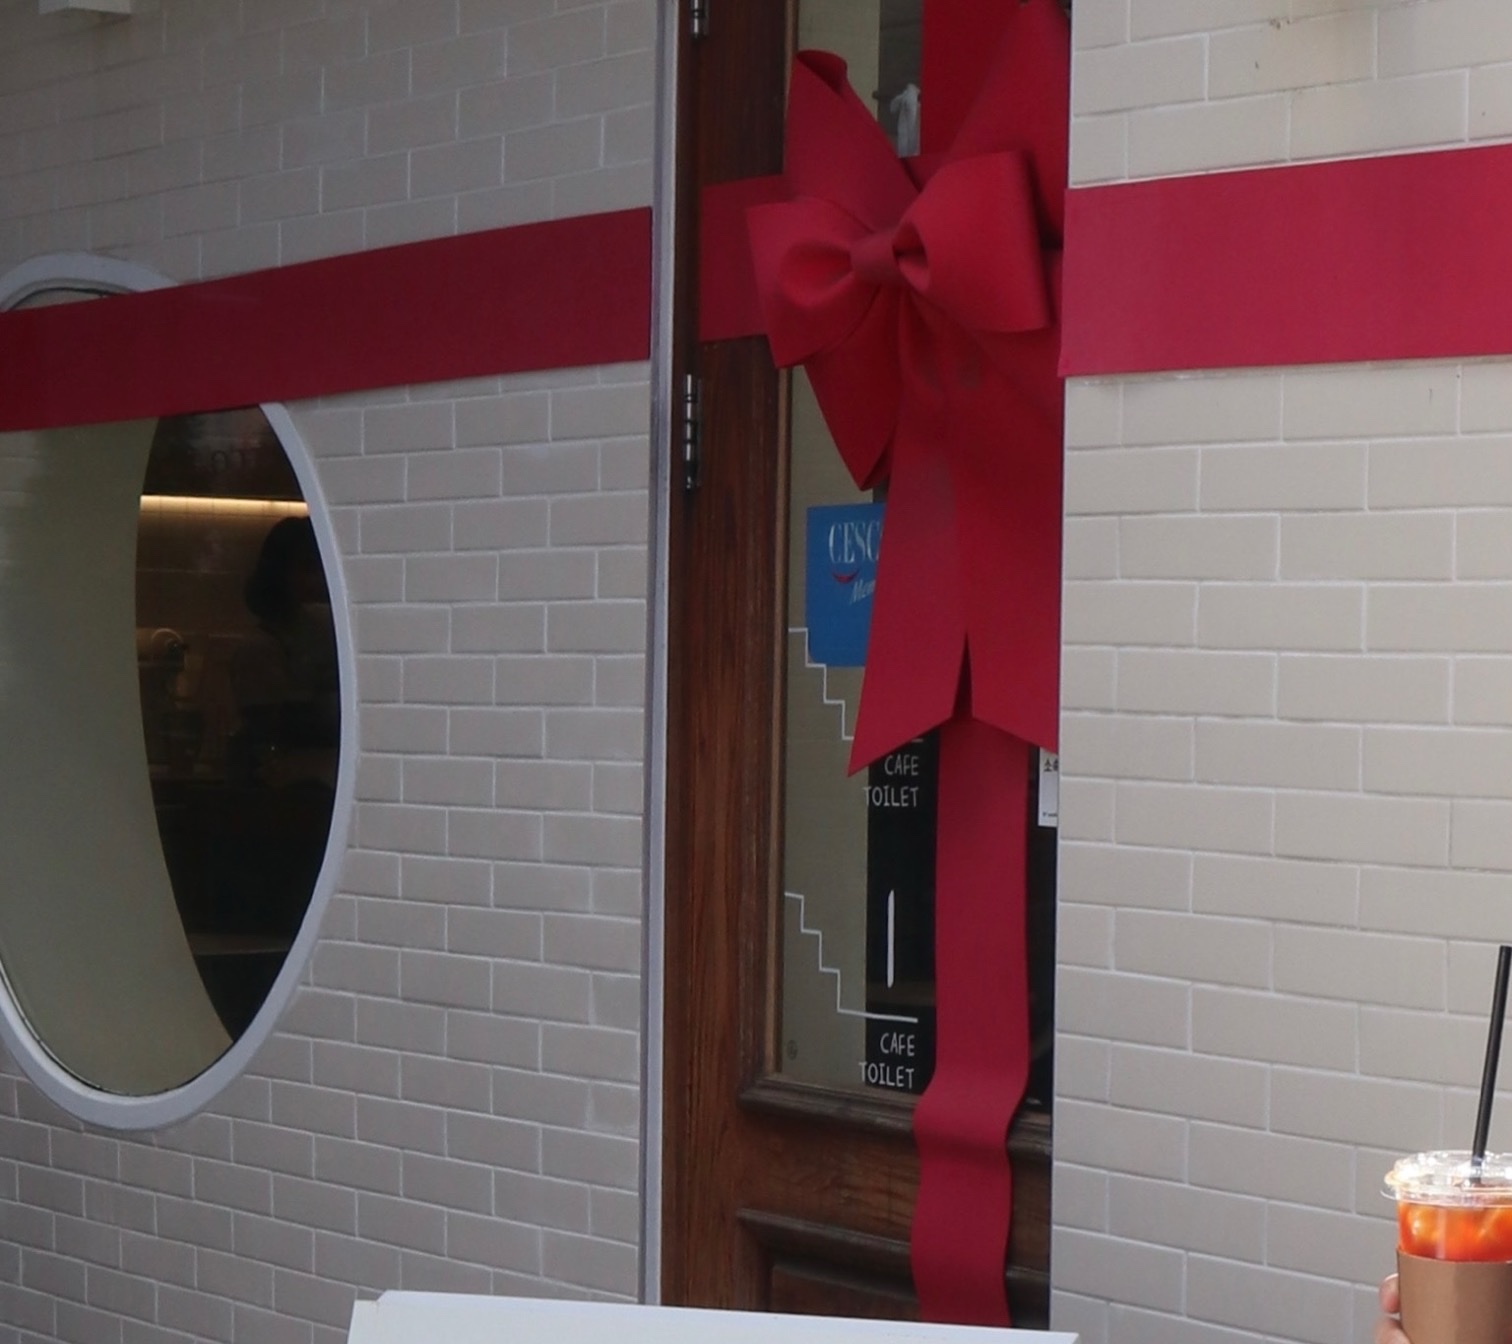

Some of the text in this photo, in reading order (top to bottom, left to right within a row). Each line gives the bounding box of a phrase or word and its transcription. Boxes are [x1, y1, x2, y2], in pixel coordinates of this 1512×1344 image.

[828, 520, 882, 564] CESC
[884, 754, 919, 776] CAFE
[862, 785, 919, 808] TOILET
[880, 1031, 915, 1056] CAFE
[858, 1061, 915, 1089] TOILET
